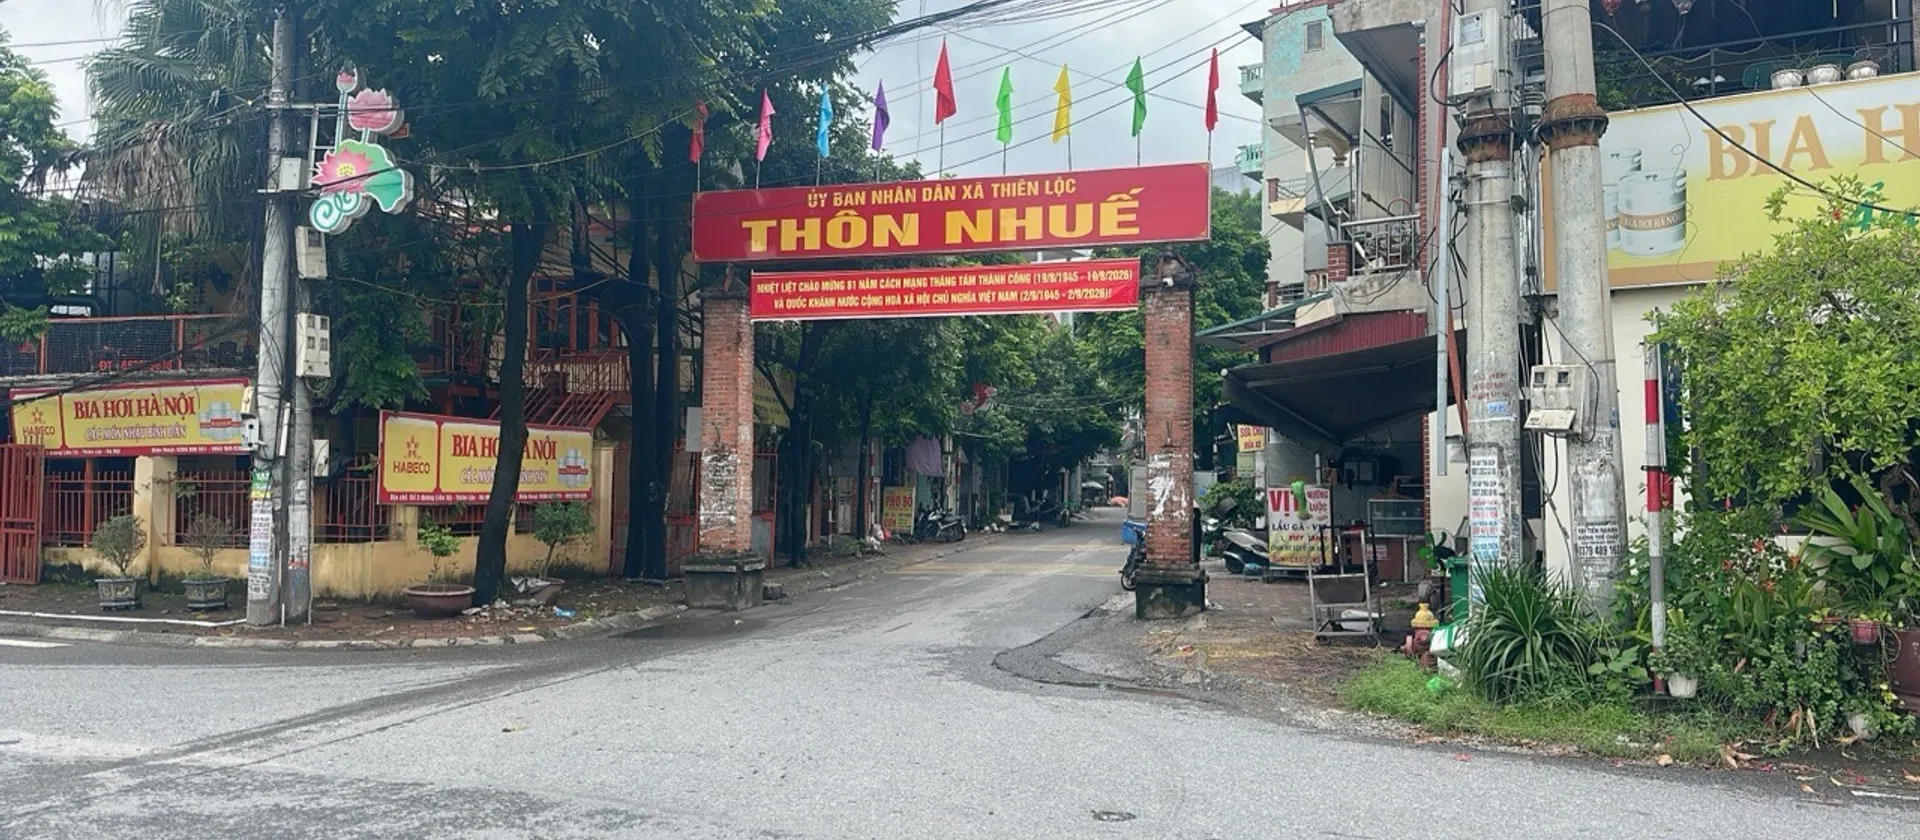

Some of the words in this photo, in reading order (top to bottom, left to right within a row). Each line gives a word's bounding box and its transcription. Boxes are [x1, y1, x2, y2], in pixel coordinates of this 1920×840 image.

[1702, 114, 1833, 182] BIA
[807, 185, 830, 208] ỦY
[833, 190, 868, 208] BAN
[871, 185, 918, 205] NHÂN
[921, 182, 956, 203] DÂN
[962, 180, 986, 201] XÃ
[991, 177, 1040, 199] THIÊN
[1045, 175, 1077, 197] LỘC
[741, 208, 920, 253] THÔN
[944, 186, 1146, 245] NHUẾ
[757, 281, 779, 295] NHIỆT
[781, 280, 797, 294] LIỆT
[798, 279, 819, 292] CHÀO
[821, 278, 845, 291] MỪNG
[858, 277, 878, 290] NĂM
[879, 275, 901, 289] CÁCH
[903, 276, 928, 290] MẠNG
[930, 274, 957, 288] THÁNG
[959, 273, 977, 286] TÁM
[1008, 271, 1032, 285] CÔNG
[774, 296, 785, 309] VÀ
[786, 295, 807, 309] QUỐC
[808, 294, 836, 308] KHÁNH
[837, 293, 860, 307] NƯỚC
[861, 292, 883, 308] CỘNG
[903, 291, 914, 304] XÃ
[916, 291, 930, 307] HỘI
[932, 289, 949, 304] CHỦ
[950, 290, 976, 304] NGHĨA
[978, 289, 997, 305] VIỆT
[998, 290, 1018, 301] NAM
[74, 400, 101, 420] BIA
[103, 398, 133, 418] HƠI
[137, 393, 162, 417] HÀ
[163, 391, 196, 421] NỘI
[22, 425, 56, 436] HABECO
[85, 424, 102, 441] CÁC
[123, 423, 146, 443] NHẬU
[147, 422, 168, 439] BÌNH
[168, 421, 187, 439] DÂN
[452, 434, 478, 458] BIA
[532, 435, 557, 465] NỘI
[393, 461, 430, 475] HABECO
[460, 465, 477, 485] CÁC
[1292, 521, 1304, 531] GÀ
